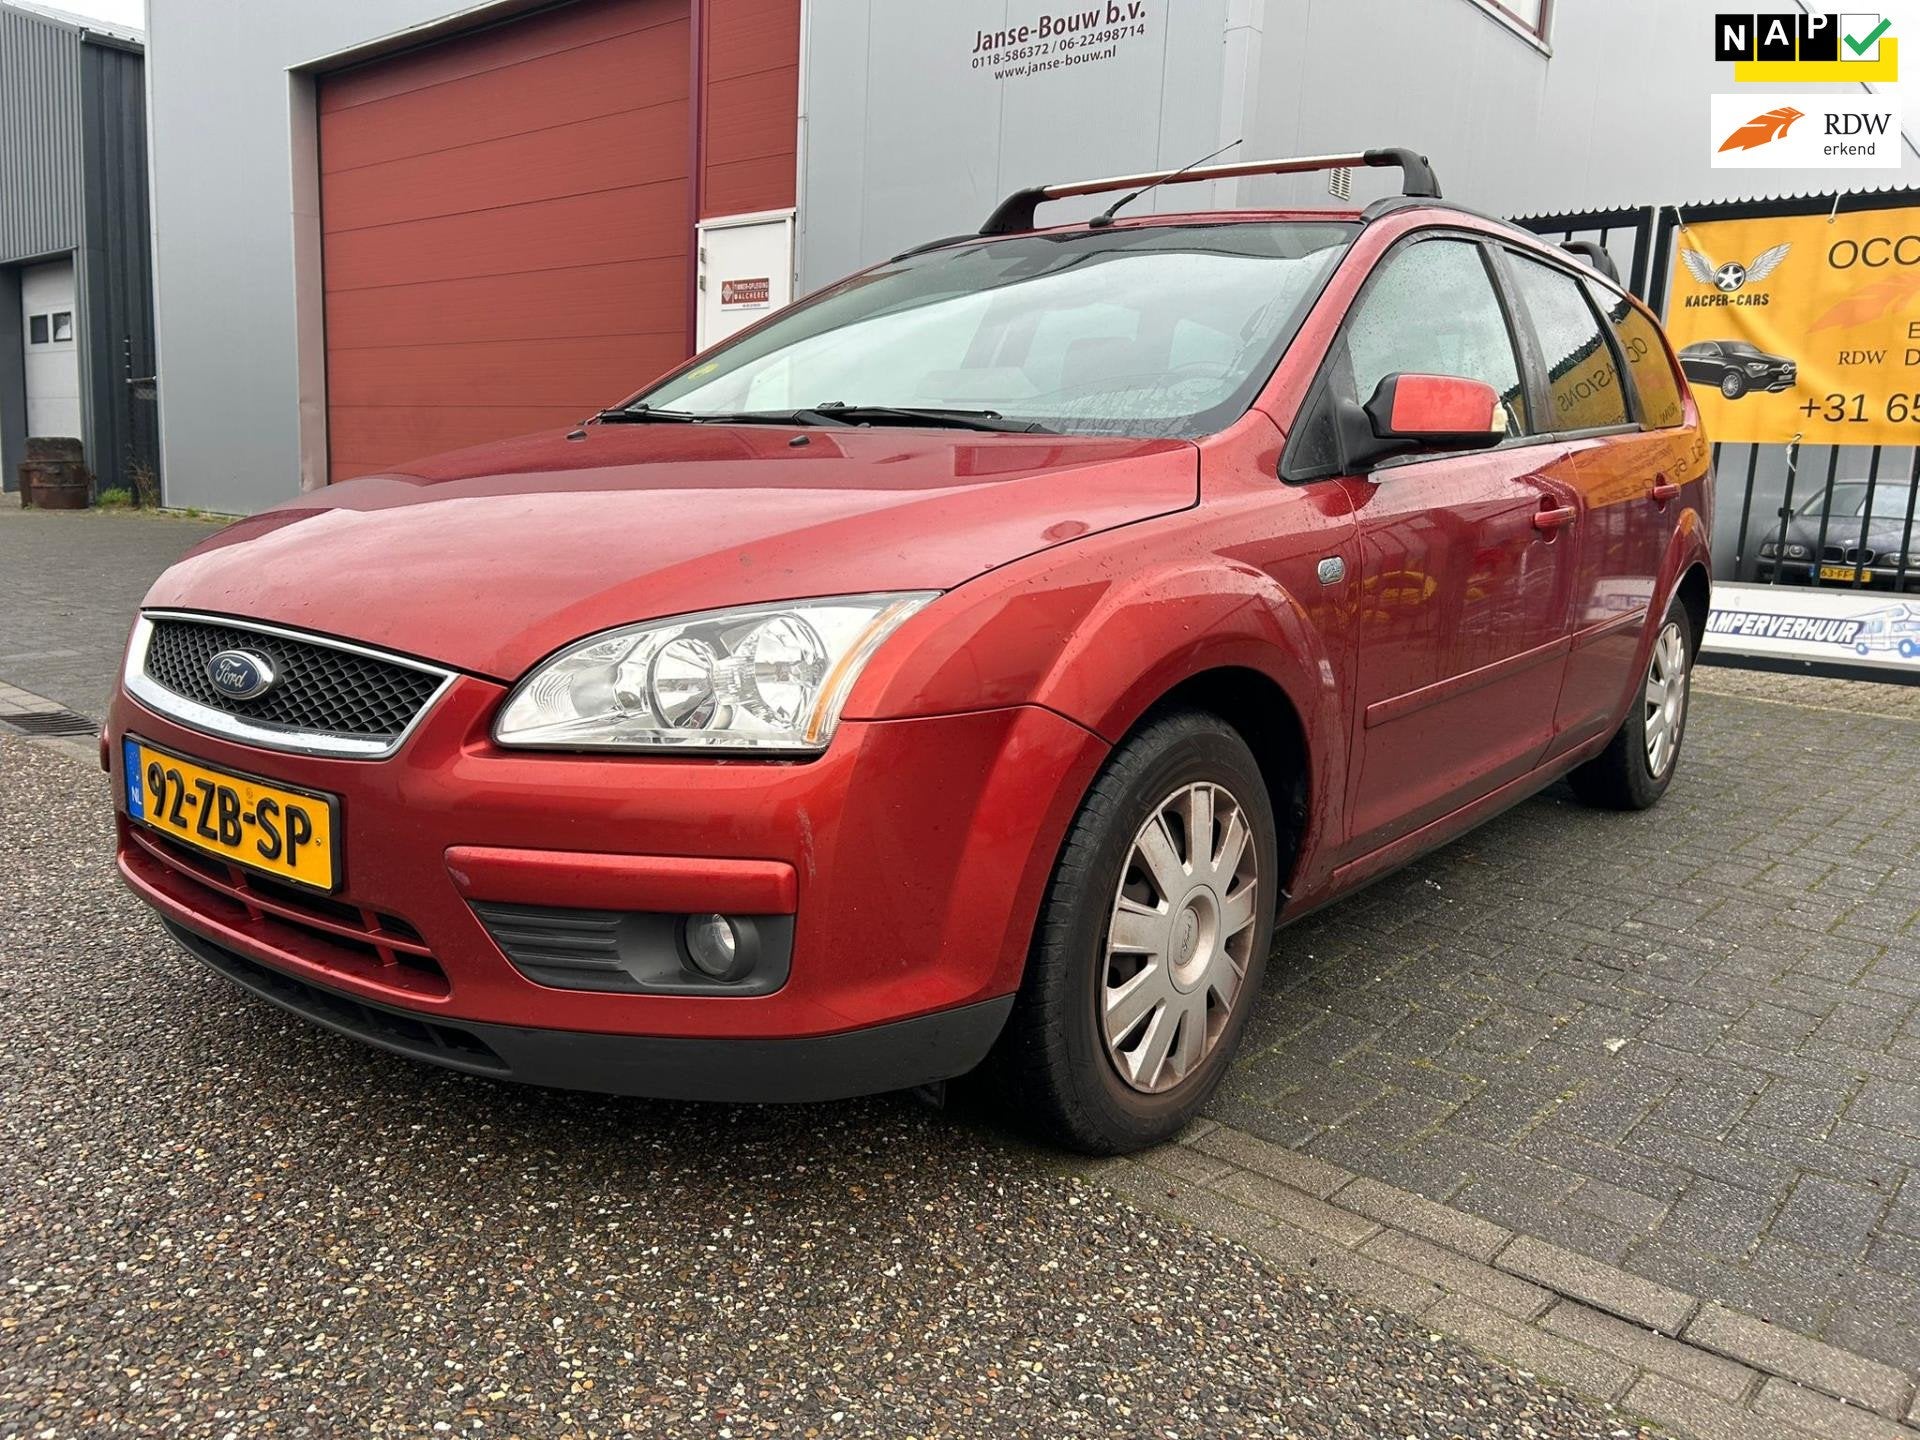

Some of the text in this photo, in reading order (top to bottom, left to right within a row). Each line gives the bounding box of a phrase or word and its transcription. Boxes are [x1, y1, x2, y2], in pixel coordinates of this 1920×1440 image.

[973, 0, 1146, 53] Janse-Bouw b.v.
[972, 43, 1049, 69] 0118-586372
[1060, 23, 1145, 51] 06-22498714
[995, 45, 1117, 80] www.janse-bouw.nl
[1685, 293, 1770, 308] KACPER-CARS
[1838, 350, 1887, 365] RDW
[1799, 394, 1869, 422] +31
[216, 658, 247, 688] Ford
[131, 785, 142, 805] NL
[147, 762, 312, 867] 92-ZB-SP
